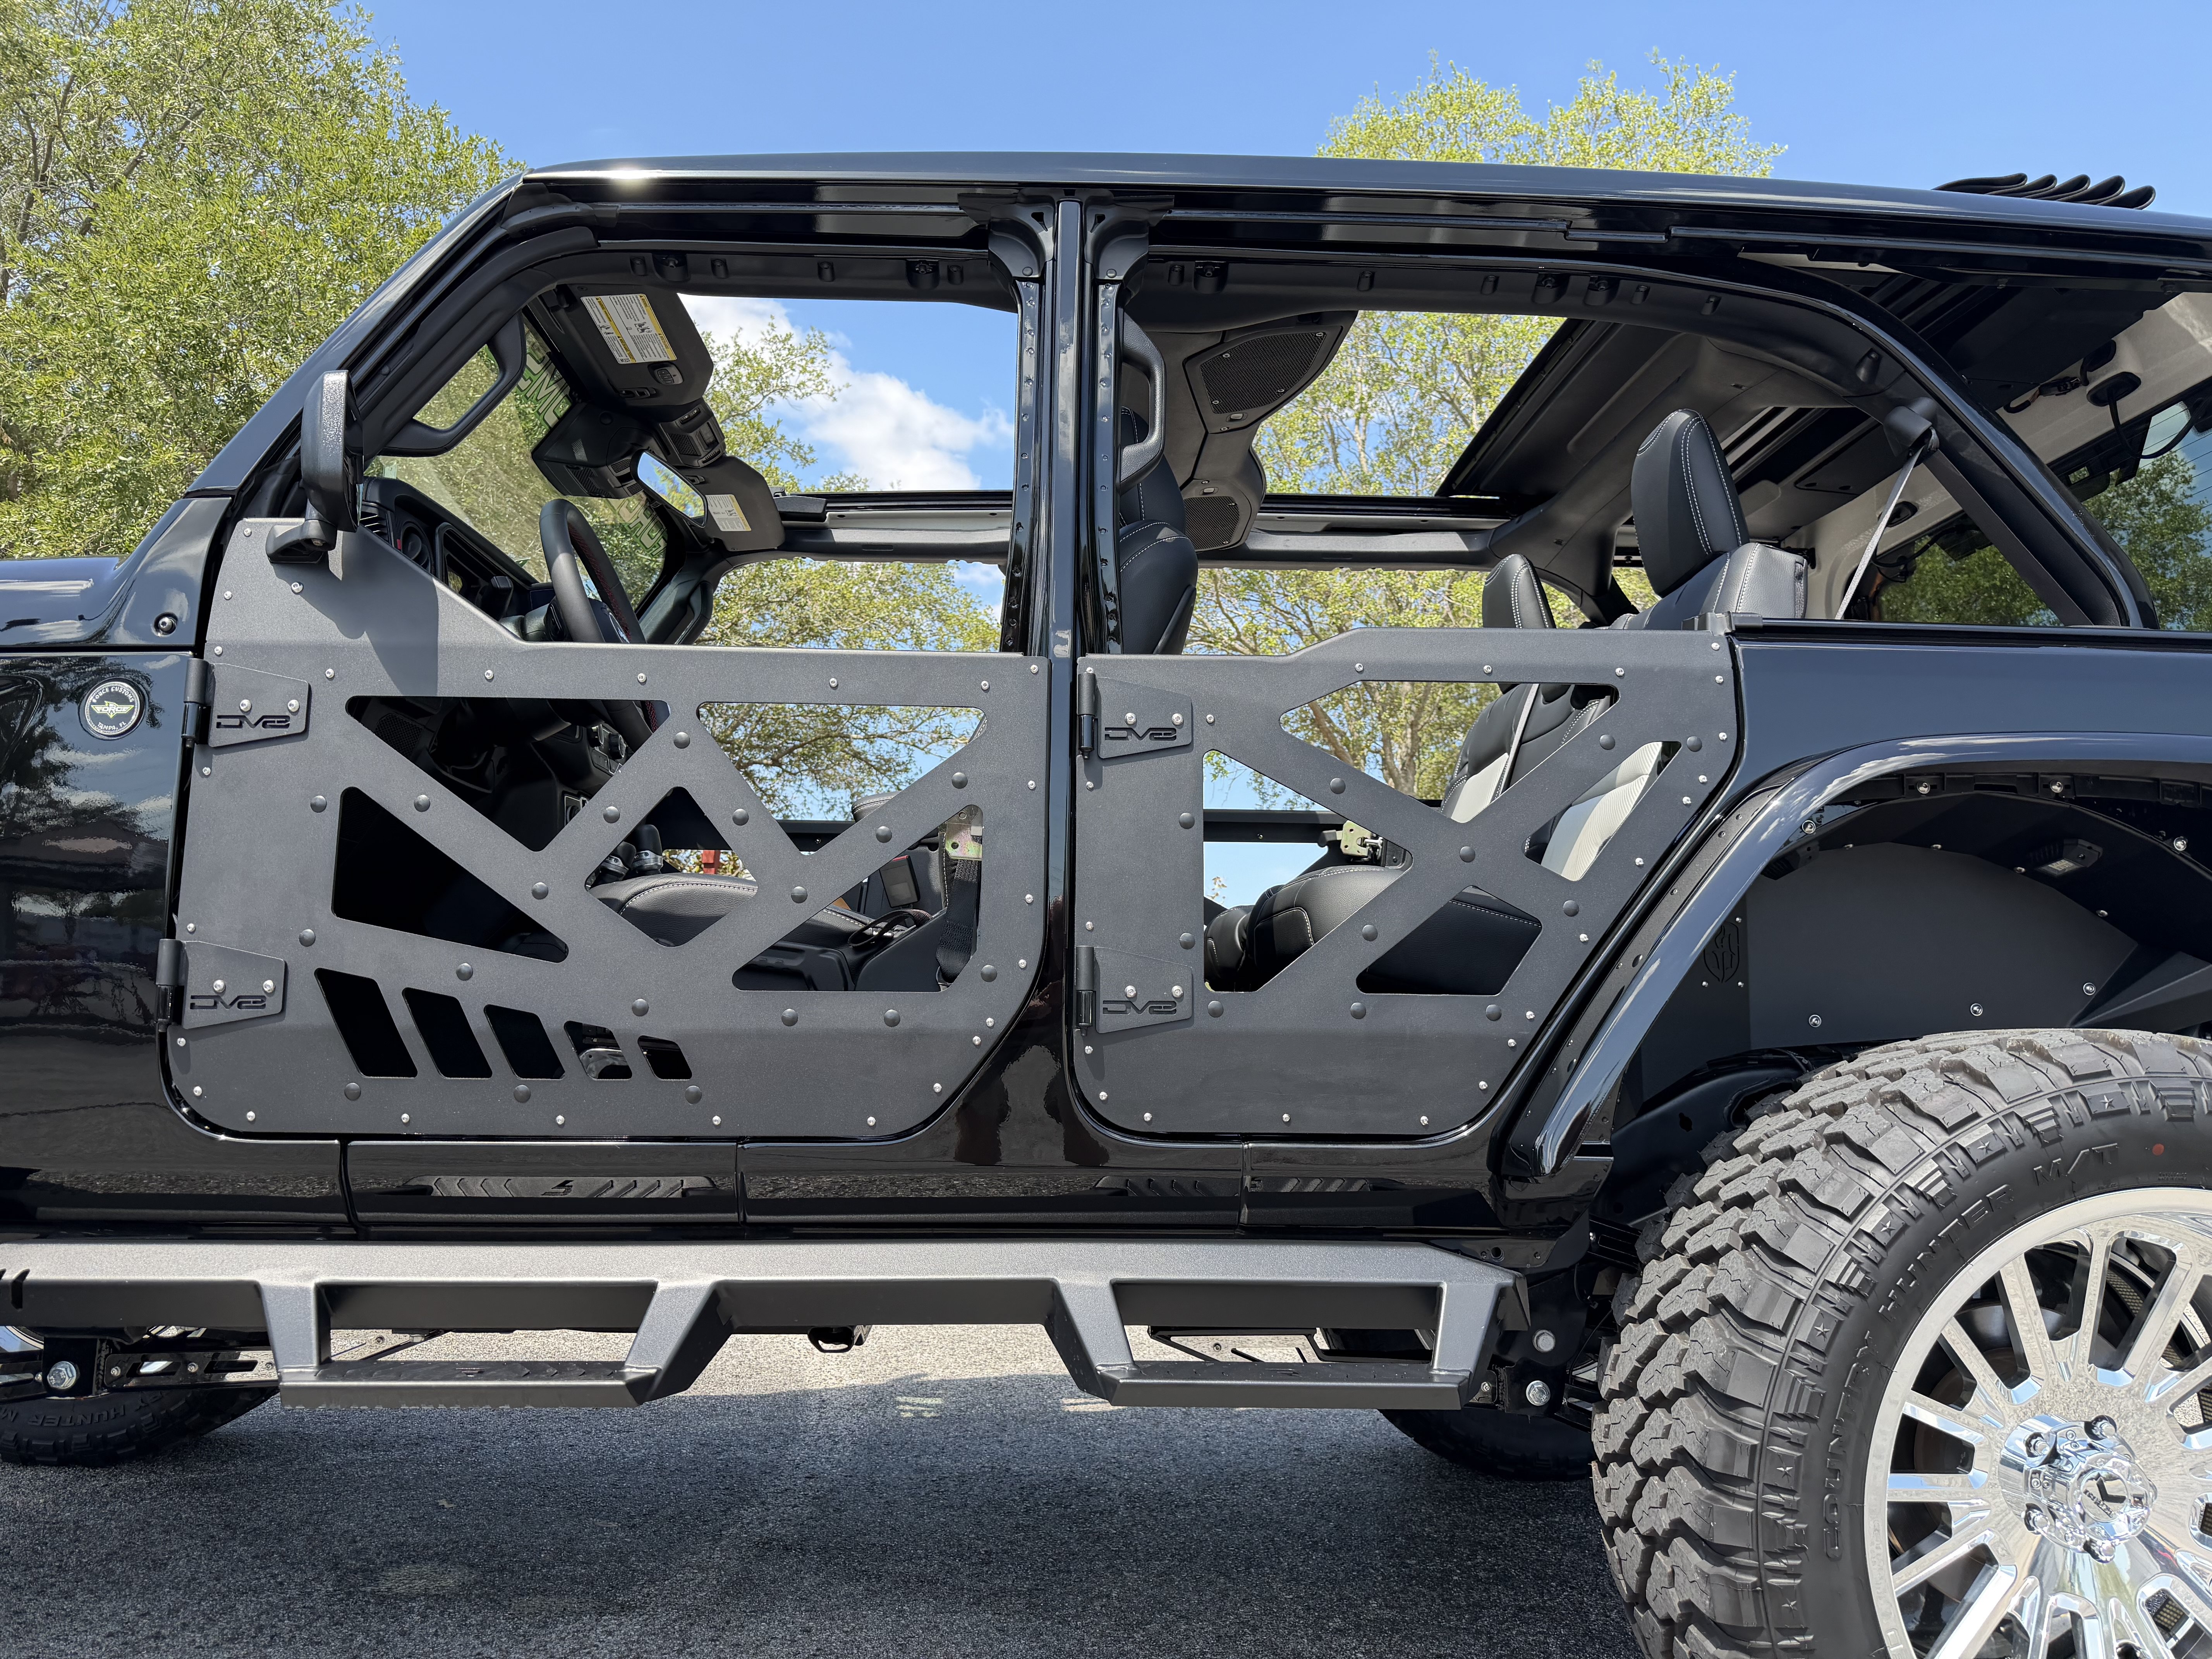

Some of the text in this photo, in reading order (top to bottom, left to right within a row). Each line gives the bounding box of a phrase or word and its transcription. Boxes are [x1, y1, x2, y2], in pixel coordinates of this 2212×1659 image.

[92, 687, 134, 703] FORCE CUSTOMS
[94, 703, 129, 713] FORCE
[1824, 1143, 2119, 1559] COUNTRY HUNTER M/T
[28, 1405, 125, 1427] HUNTER
